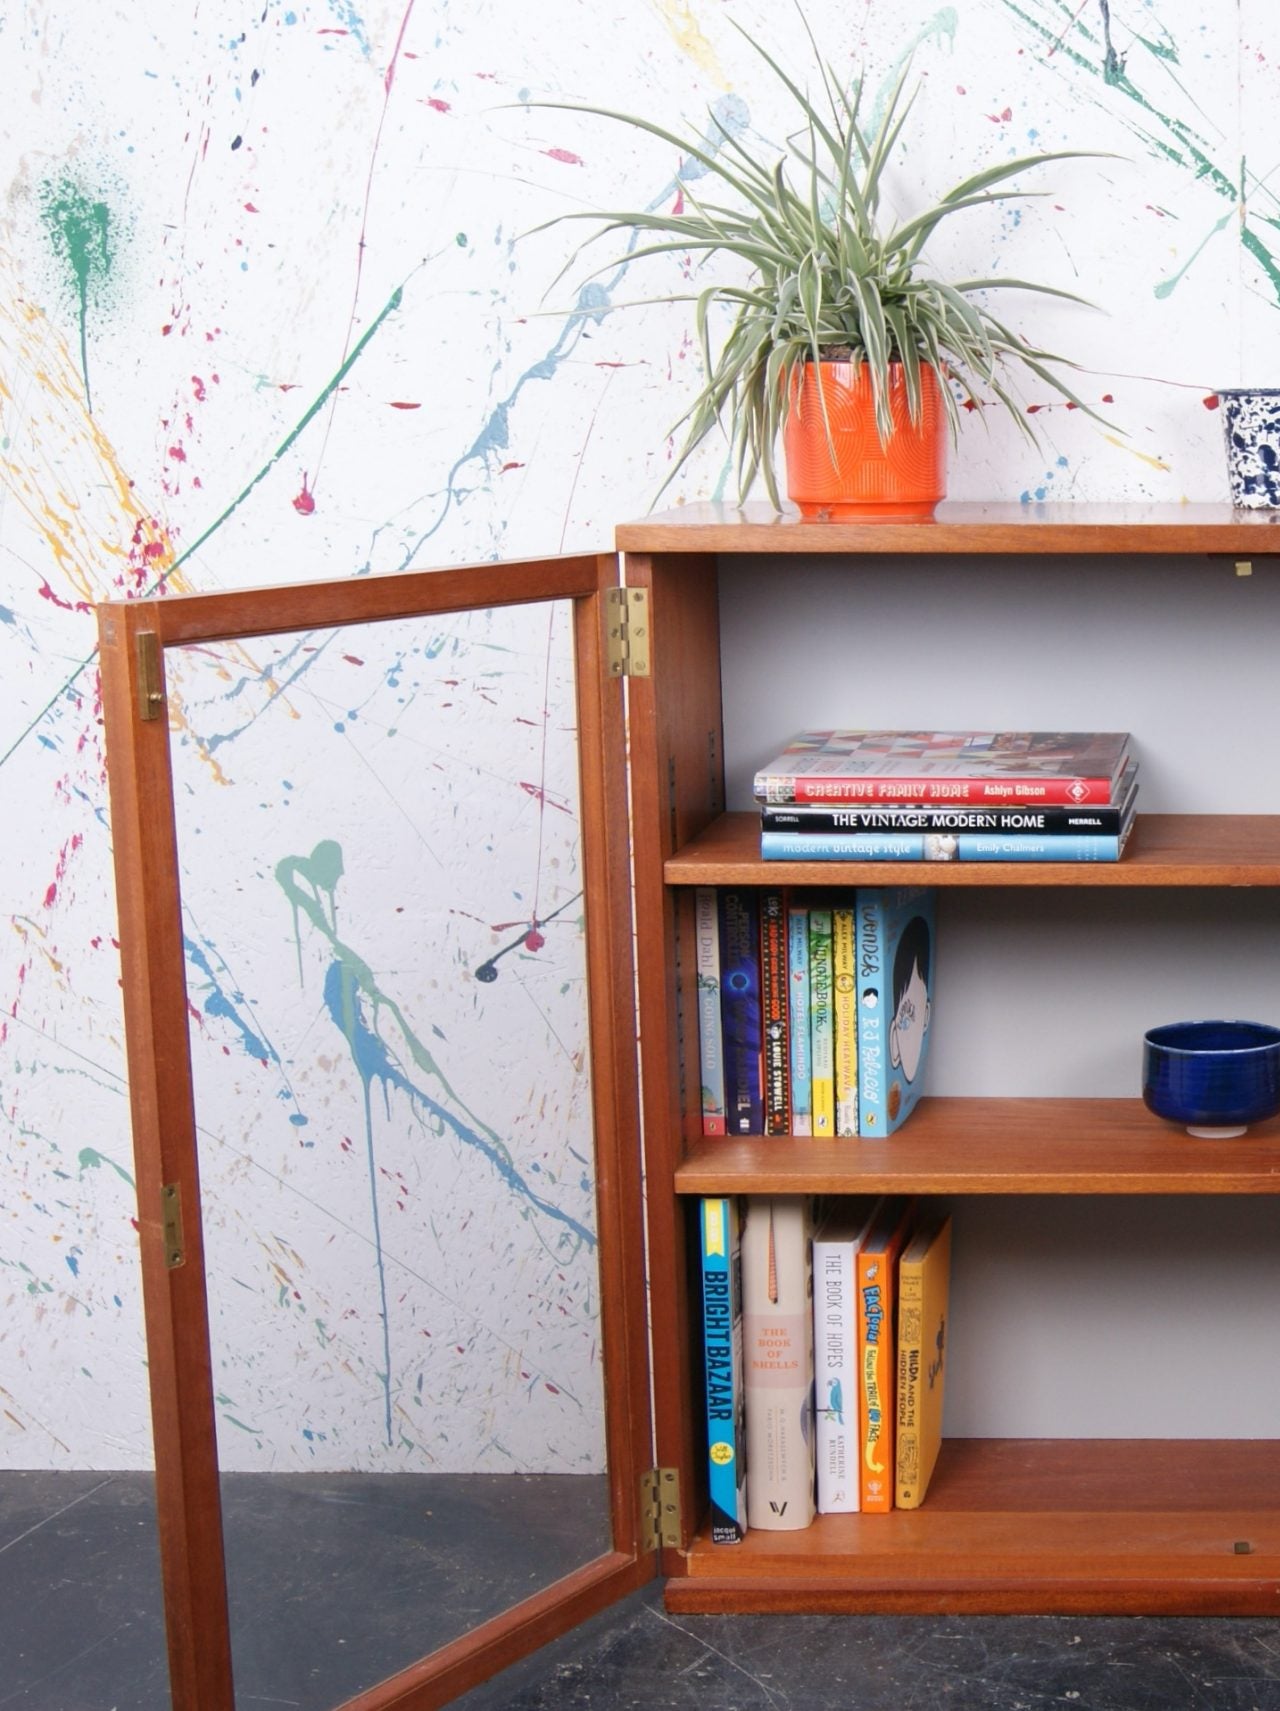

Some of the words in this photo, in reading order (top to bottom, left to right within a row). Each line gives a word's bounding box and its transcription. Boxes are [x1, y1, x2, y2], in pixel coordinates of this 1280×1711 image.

[805, 783, 874, 798] CREATIVE
[878, 783, 927, 798] FAMILY
[984, 784, 1014, 797] Ashlyn
[1015, 785, 1046, 796] Gibson
[775, 815, 800, 823] SORRELL
[832, 813, 857, 827] THE
[860, 814, 929, 828] VINTAGE
[931, 814, 998, 828] MODERN
[1000, 814, 1046, 828] HOME
[1068, 817, 1103, 826] MERRELL
[783, 843, 830, 854] modern
[832, 843, 881, 857] vintage
[882, 842, 912, 857] style
[976, 842, 1001, 854] Emily
[1002, 842, 1045, 853] Chalmers
[700, 894, 714, 933] Roald
[700, 936, 714, 969] Dahl
[704, 997, 716, 1036] GOING
[796, 991, 806, 1024] HOTEL
[813, 991, 829, 1033] BOOK
[841, 996, 850, 1037] HOLIDAY
[705, 1037, 717, 1070] SOLO
[772, 1041, 782, 1068] LOUIE
[843, 1039, 851, 1094] HEATWAVE
[773, 1070, 783, 1111] STOWELL
[826, 1255, 841, 1275] THE
[704, 1270, 731, 1342] BRIGHT
[826, 1280, 842, 1308] BOOK
[761, 1327, 788, 1337] THE
[826, 1314, 842, 1328] OF
[758, 1338, 791, 1348] BOOK
[767, 1350, 783, 1359] OF
[827, 1333, 843, 1368] HOPES
[752, 1360, 799, 1369] SHELLS
[899, 1350, 907, 1390] HIDDEN
[909, 1349, 919, 1382] HILDA
[706, 1345, 733, 1421] BAZAAR
[867, 1381, 878, 1401] TRAIL
[907, 1386, 915, 1407] AND
[898, 1392, 907, 1427] PEOPLE
[907, 1409, 915, 1427] THE
[829, 1439, 837, 1475] RUNDELL
[836, 1435, 846, 1479] KATHERINE
